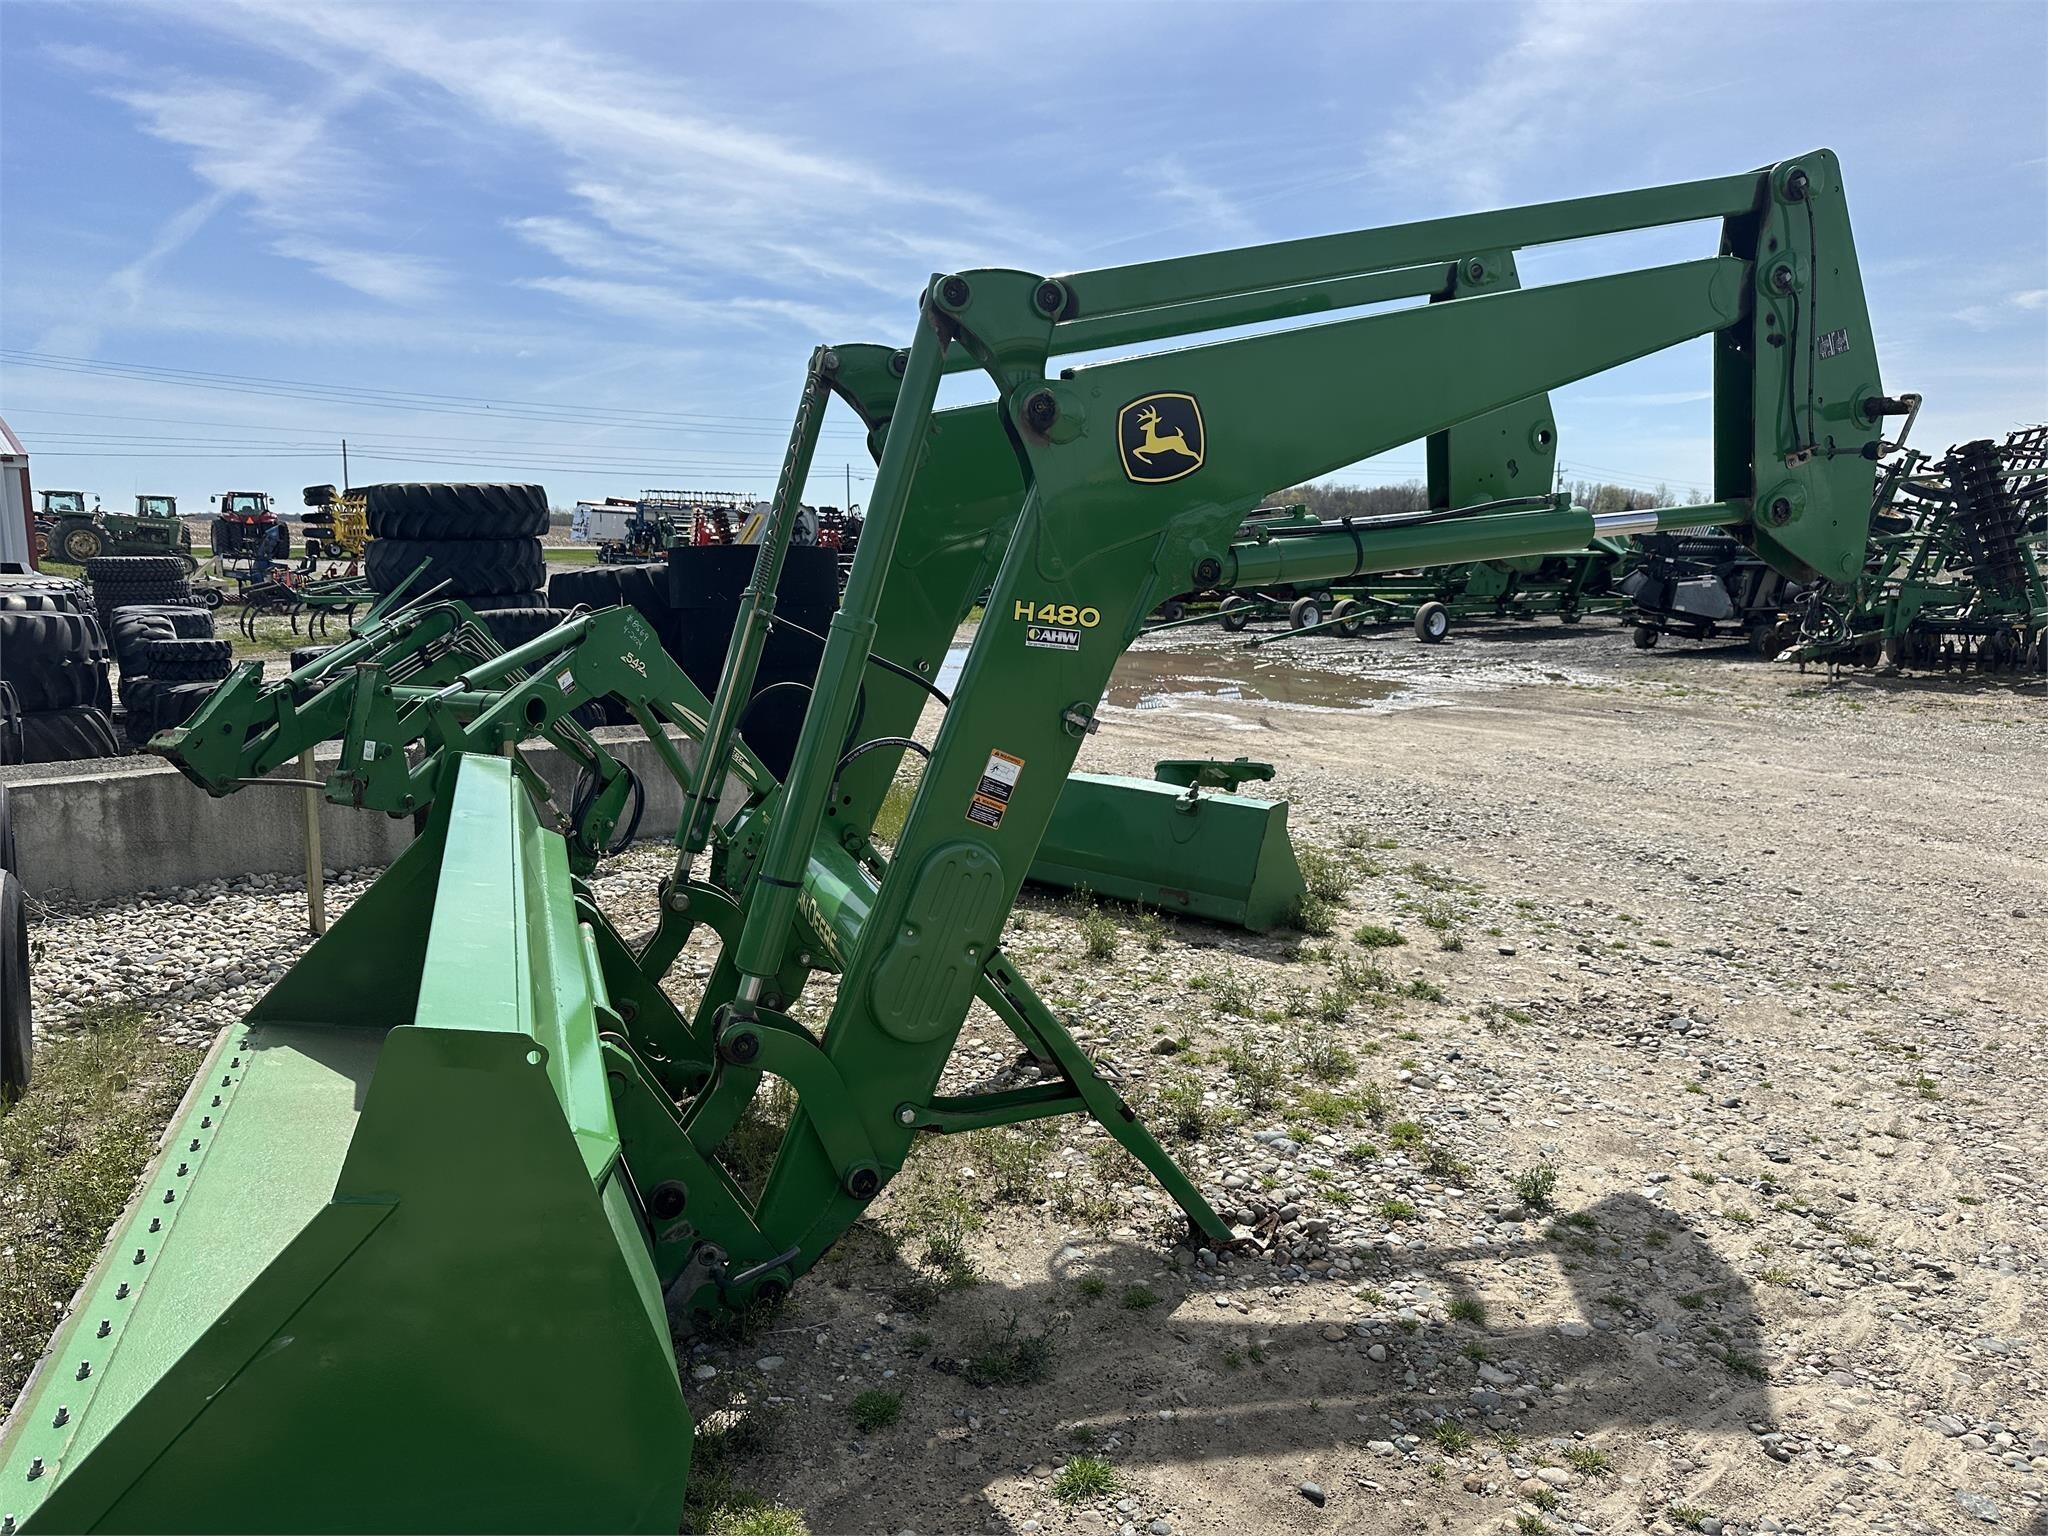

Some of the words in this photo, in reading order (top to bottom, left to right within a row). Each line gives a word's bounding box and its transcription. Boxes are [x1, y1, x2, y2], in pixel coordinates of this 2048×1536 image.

[1013, 599, 1101, 628] H480
[1040, 629, 1079, 644] AHW
[625, 651, 646, 673] 542
[808, 897, 839, 960] DEERE
